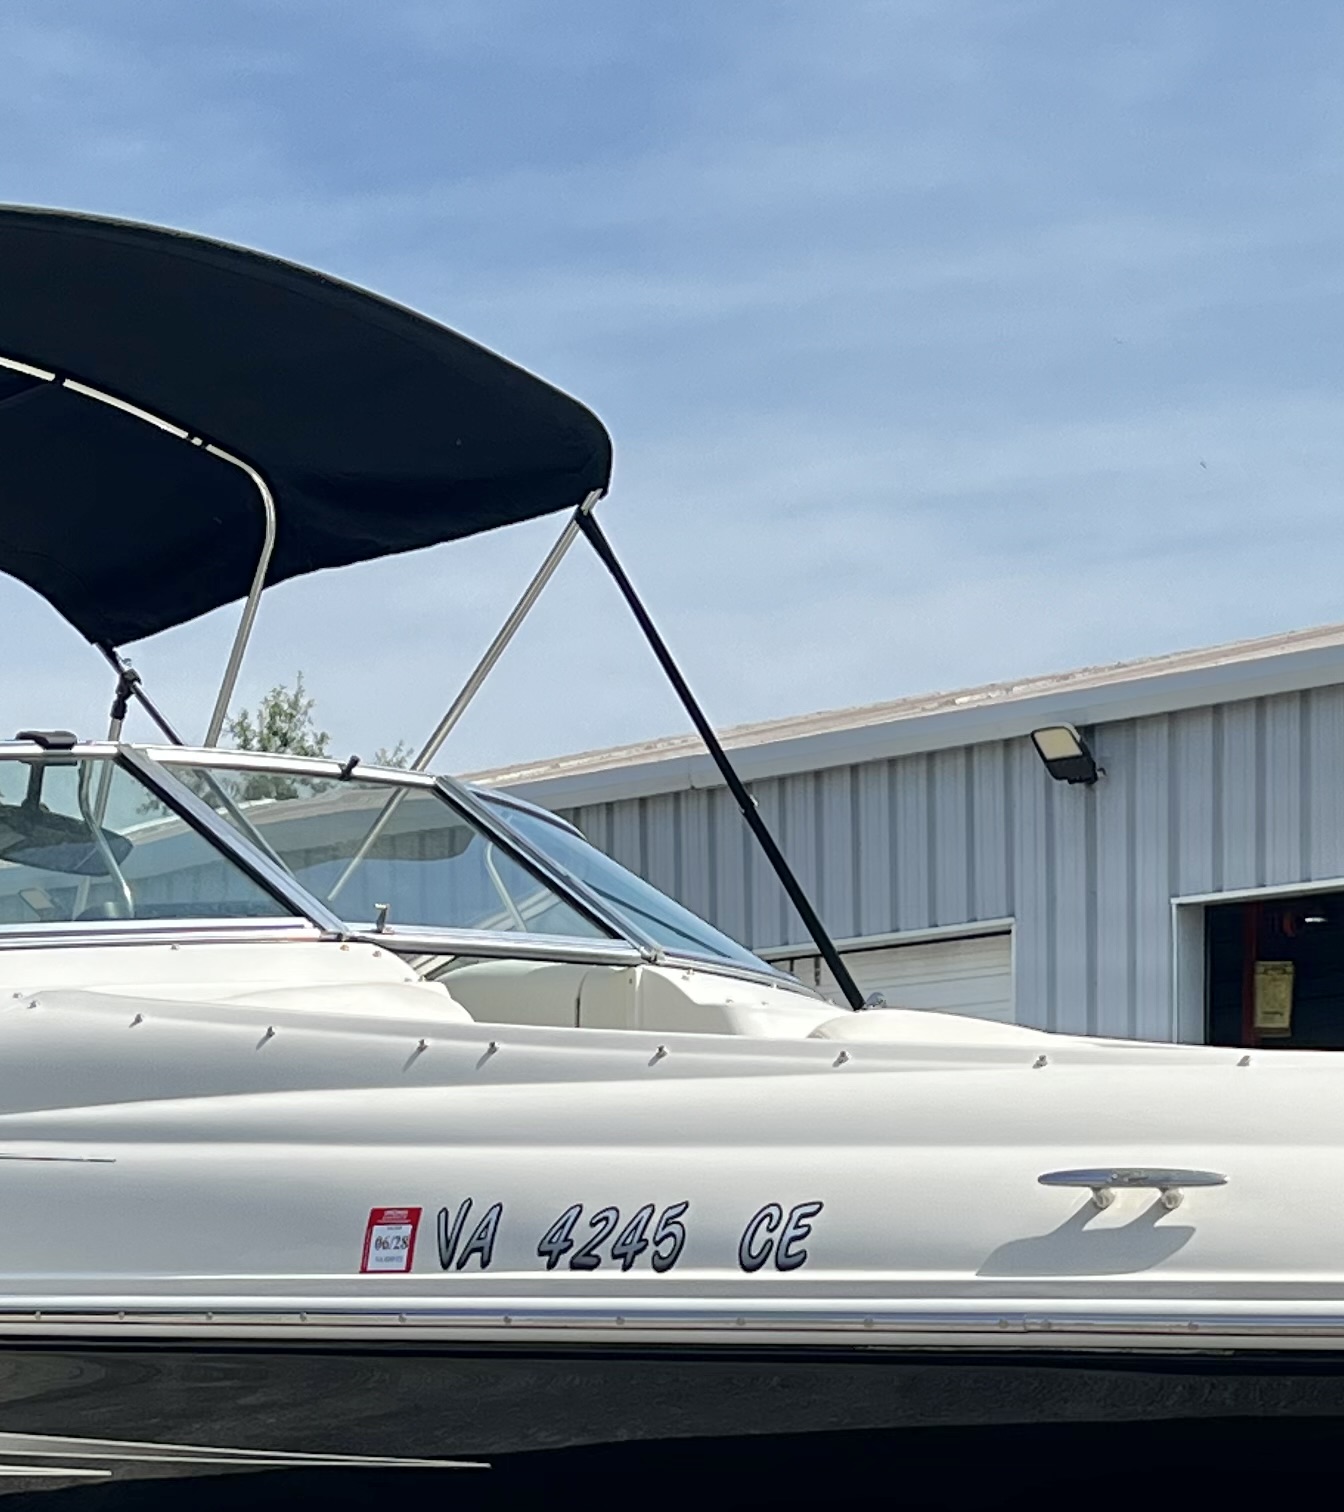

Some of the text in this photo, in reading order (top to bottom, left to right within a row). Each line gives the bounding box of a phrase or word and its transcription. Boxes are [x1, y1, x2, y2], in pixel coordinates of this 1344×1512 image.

[437, 1198, 824, 1273] VA 4245 CE
